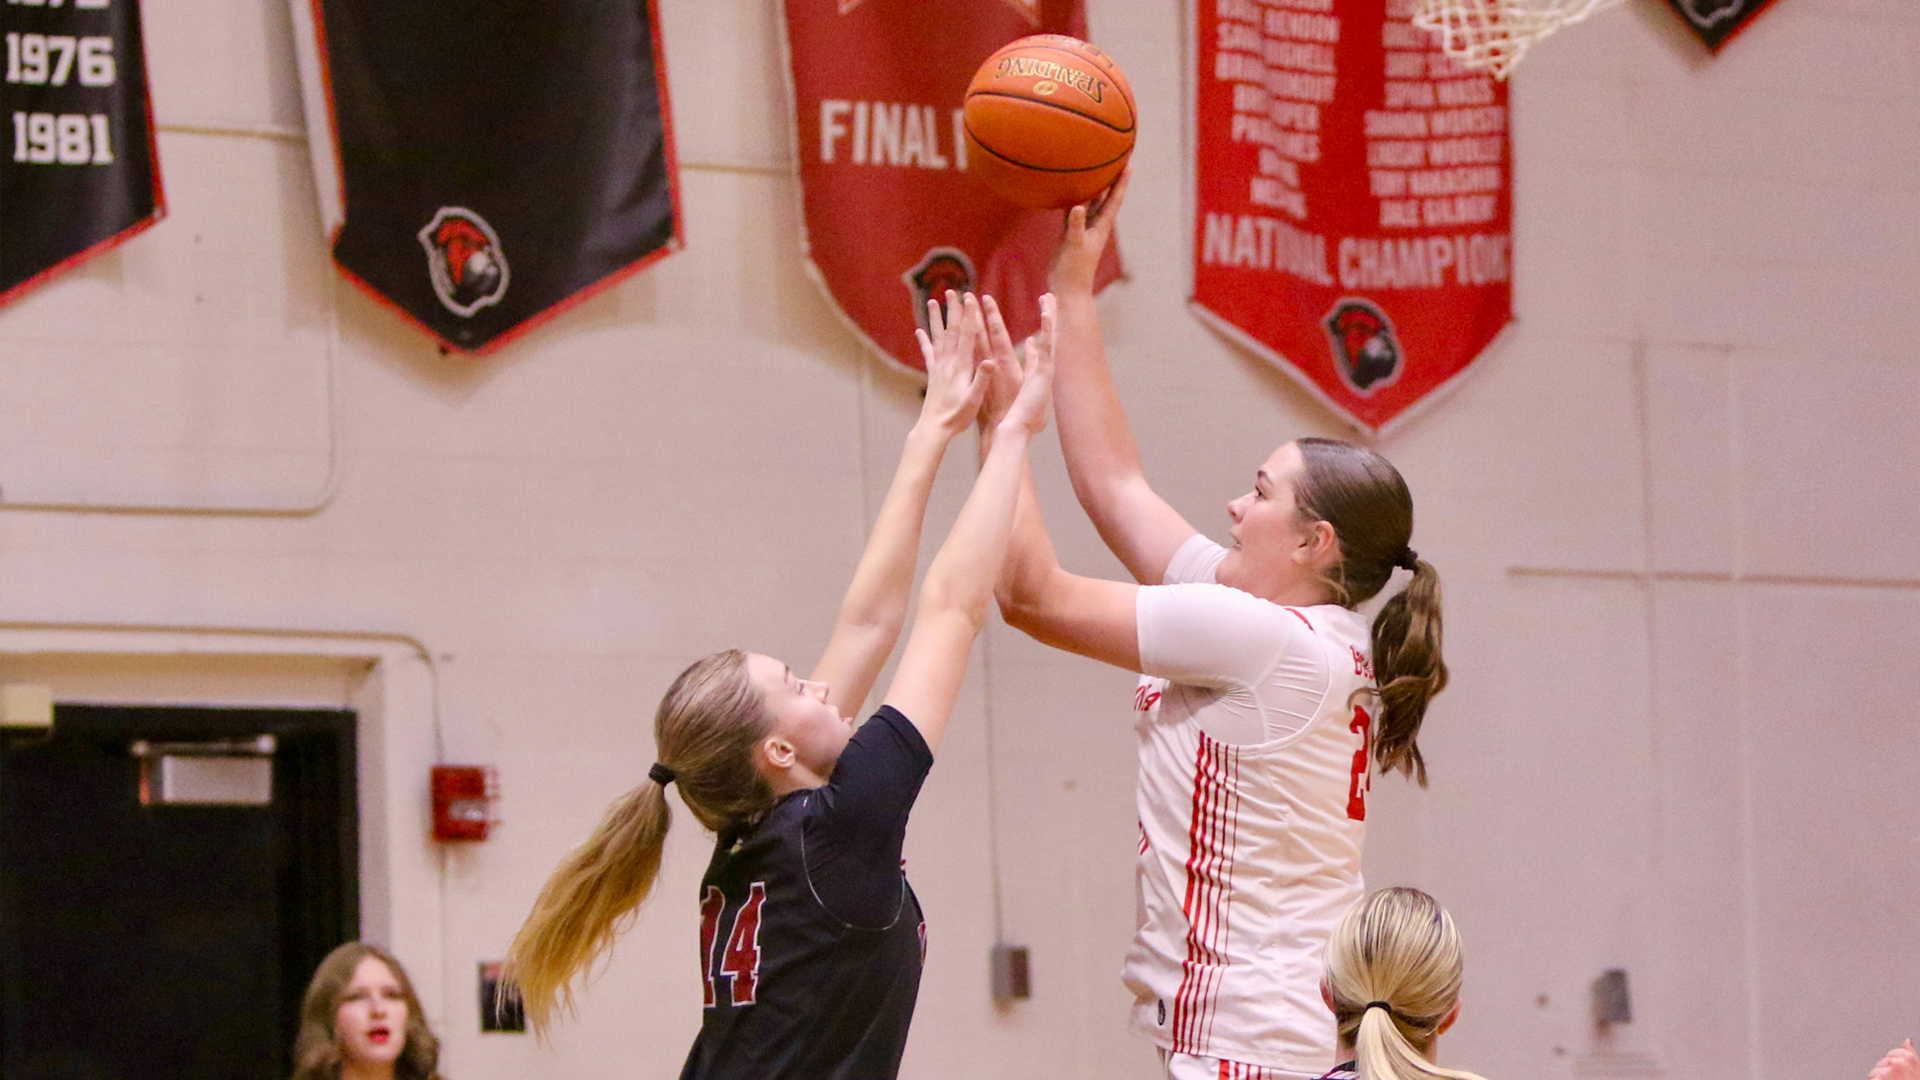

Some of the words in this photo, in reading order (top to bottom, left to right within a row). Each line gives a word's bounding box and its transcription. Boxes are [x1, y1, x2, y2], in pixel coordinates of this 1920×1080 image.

[5, 32, 117, 87] 1976
[995, 56, 1108, 104] SPALDING
[12, 111, 115, 166] 1981
[820, 99, 948, 170] FINAL
[700, 881, 766, 1008] 14
